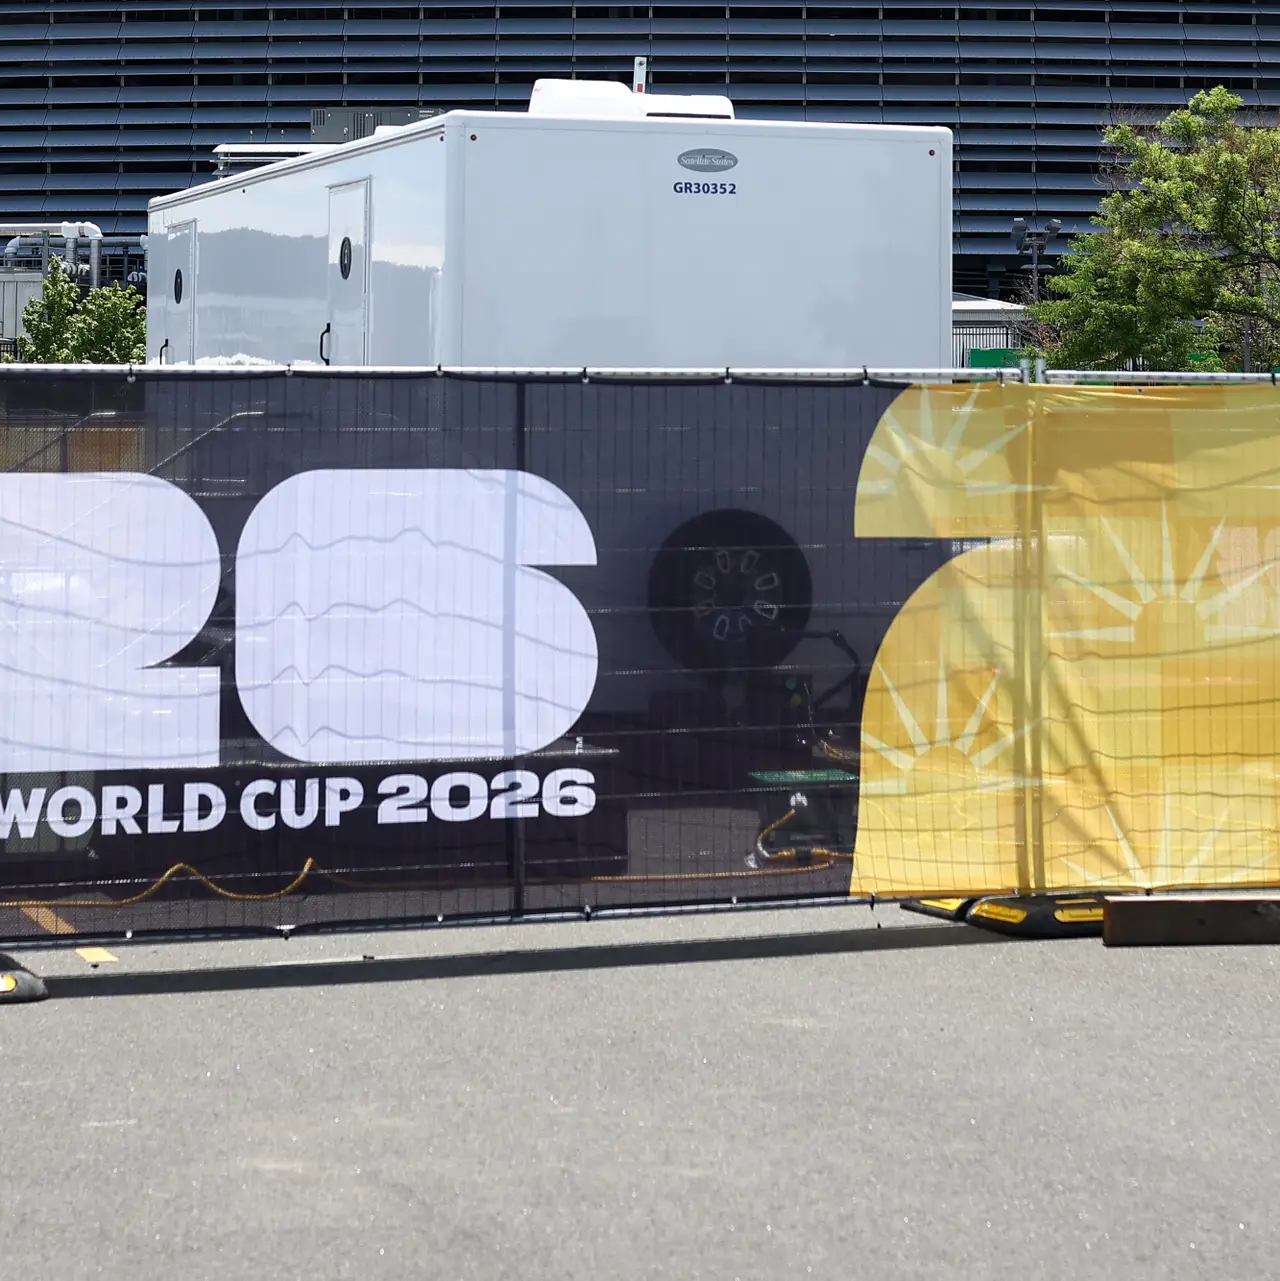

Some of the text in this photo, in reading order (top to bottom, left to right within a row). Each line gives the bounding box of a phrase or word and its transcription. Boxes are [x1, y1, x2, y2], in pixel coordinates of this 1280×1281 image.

[681, 155, 733, 165] Satellite Suites
[673, 182, 736, 194] GR30352
[240, 777, 364, 831] CUP
[377, 768, 597, 825] 2026
